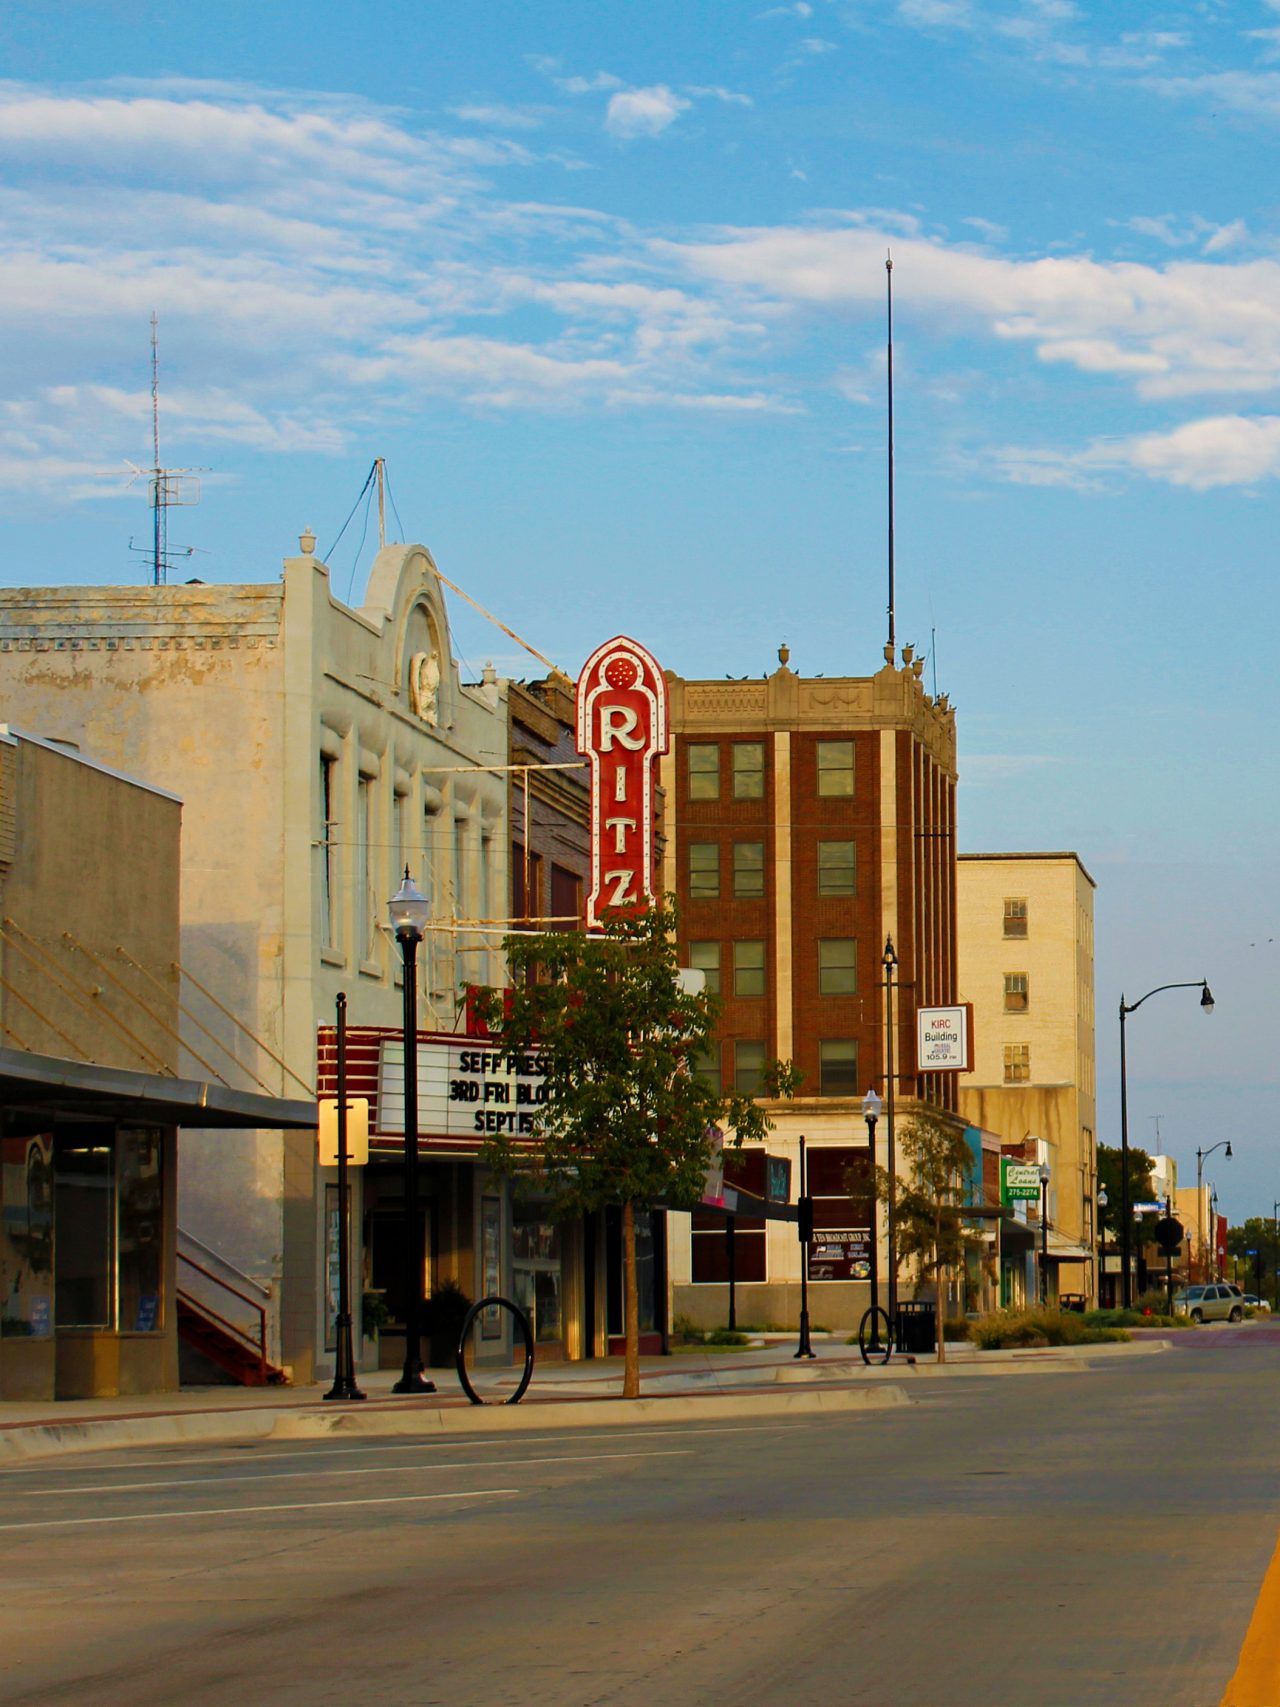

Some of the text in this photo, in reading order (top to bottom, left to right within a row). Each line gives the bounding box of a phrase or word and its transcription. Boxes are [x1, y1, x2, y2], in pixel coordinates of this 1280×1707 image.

[599, 704, 646, 907] RITZ
[931, 1019, 951, 1029] KIRC
[925, 1031, 958, 1042] Building
[449, 1080, 480, 1102] 3RD
[484, 1082, 510, 1104] FRI
[474, 1110, 534, 1134] SEPT 15
[1007, 1166, 1039, 1177] Central
[1009, 1176, 1037, 1185] Loans
